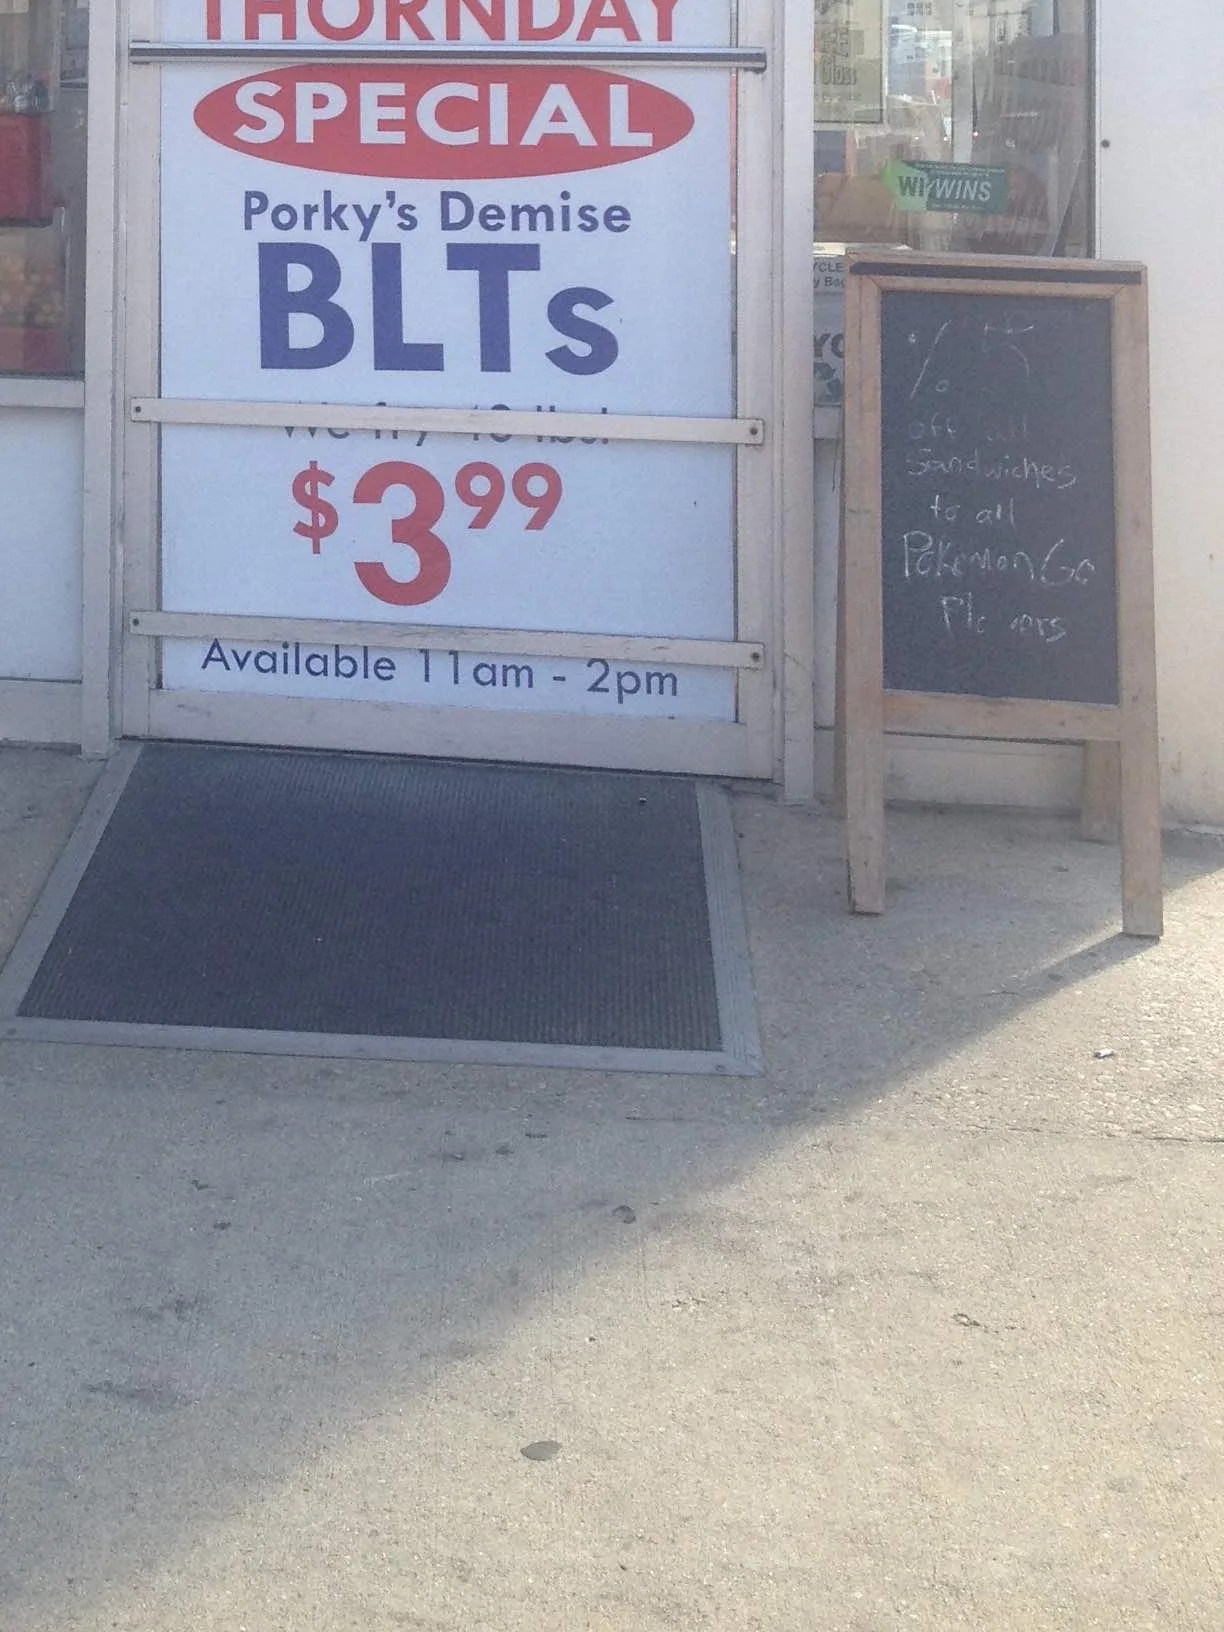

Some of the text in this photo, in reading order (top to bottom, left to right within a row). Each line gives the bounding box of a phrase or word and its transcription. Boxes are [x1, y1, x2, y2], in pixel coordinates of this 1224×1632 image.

[233, 80, 654, 148] SPECIAL
[243, 189, 632, 241] Porky's Demise
[935, 177, 993, 203] WINS
[257, 241, 620, 376] BLTs
[905, 446, 1078, 490] Sandwiches
[929, 494, 1017, 530] to all
[200, 637, 397, 683] Available
[418, 648, 535, 690] 11am
[586, 658, 679, 705] 2pm
